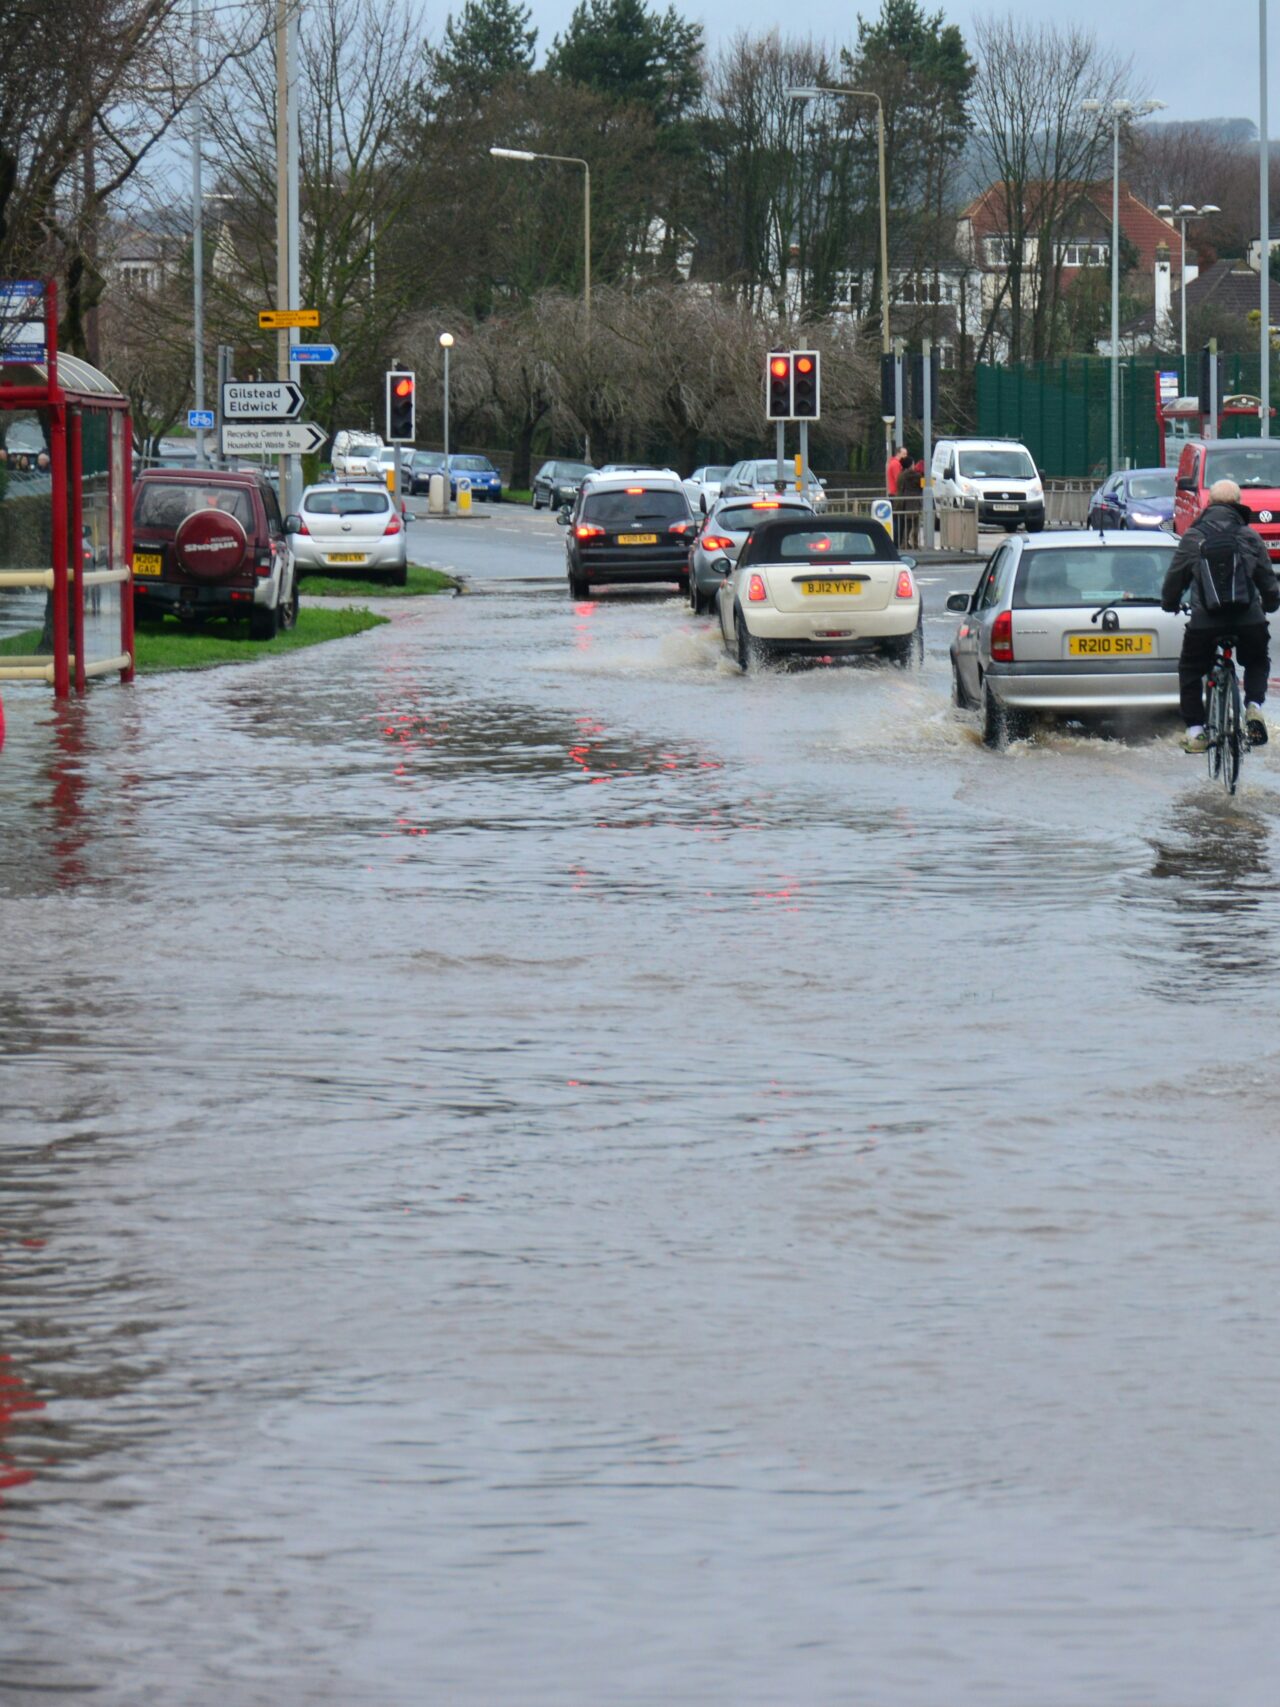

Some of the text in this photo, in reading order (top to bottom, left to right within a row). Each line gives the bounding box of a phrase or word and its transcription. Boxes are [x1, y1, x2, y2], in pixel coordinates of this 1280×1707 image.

[229, 388, 281, 398] Gilstead
[229, 401, 278, 412] Eldwick
[227, 430, 259, 439] Recycling
[261, 430, 283, 438] Centre
[227, 441, 301, 449] Household Waste Site
[184, 541, 238, 553] Shogun
[808, 582, 855, 593] BJ12 YYF
[1078, 637, 1143, 653] R210 SRJ
